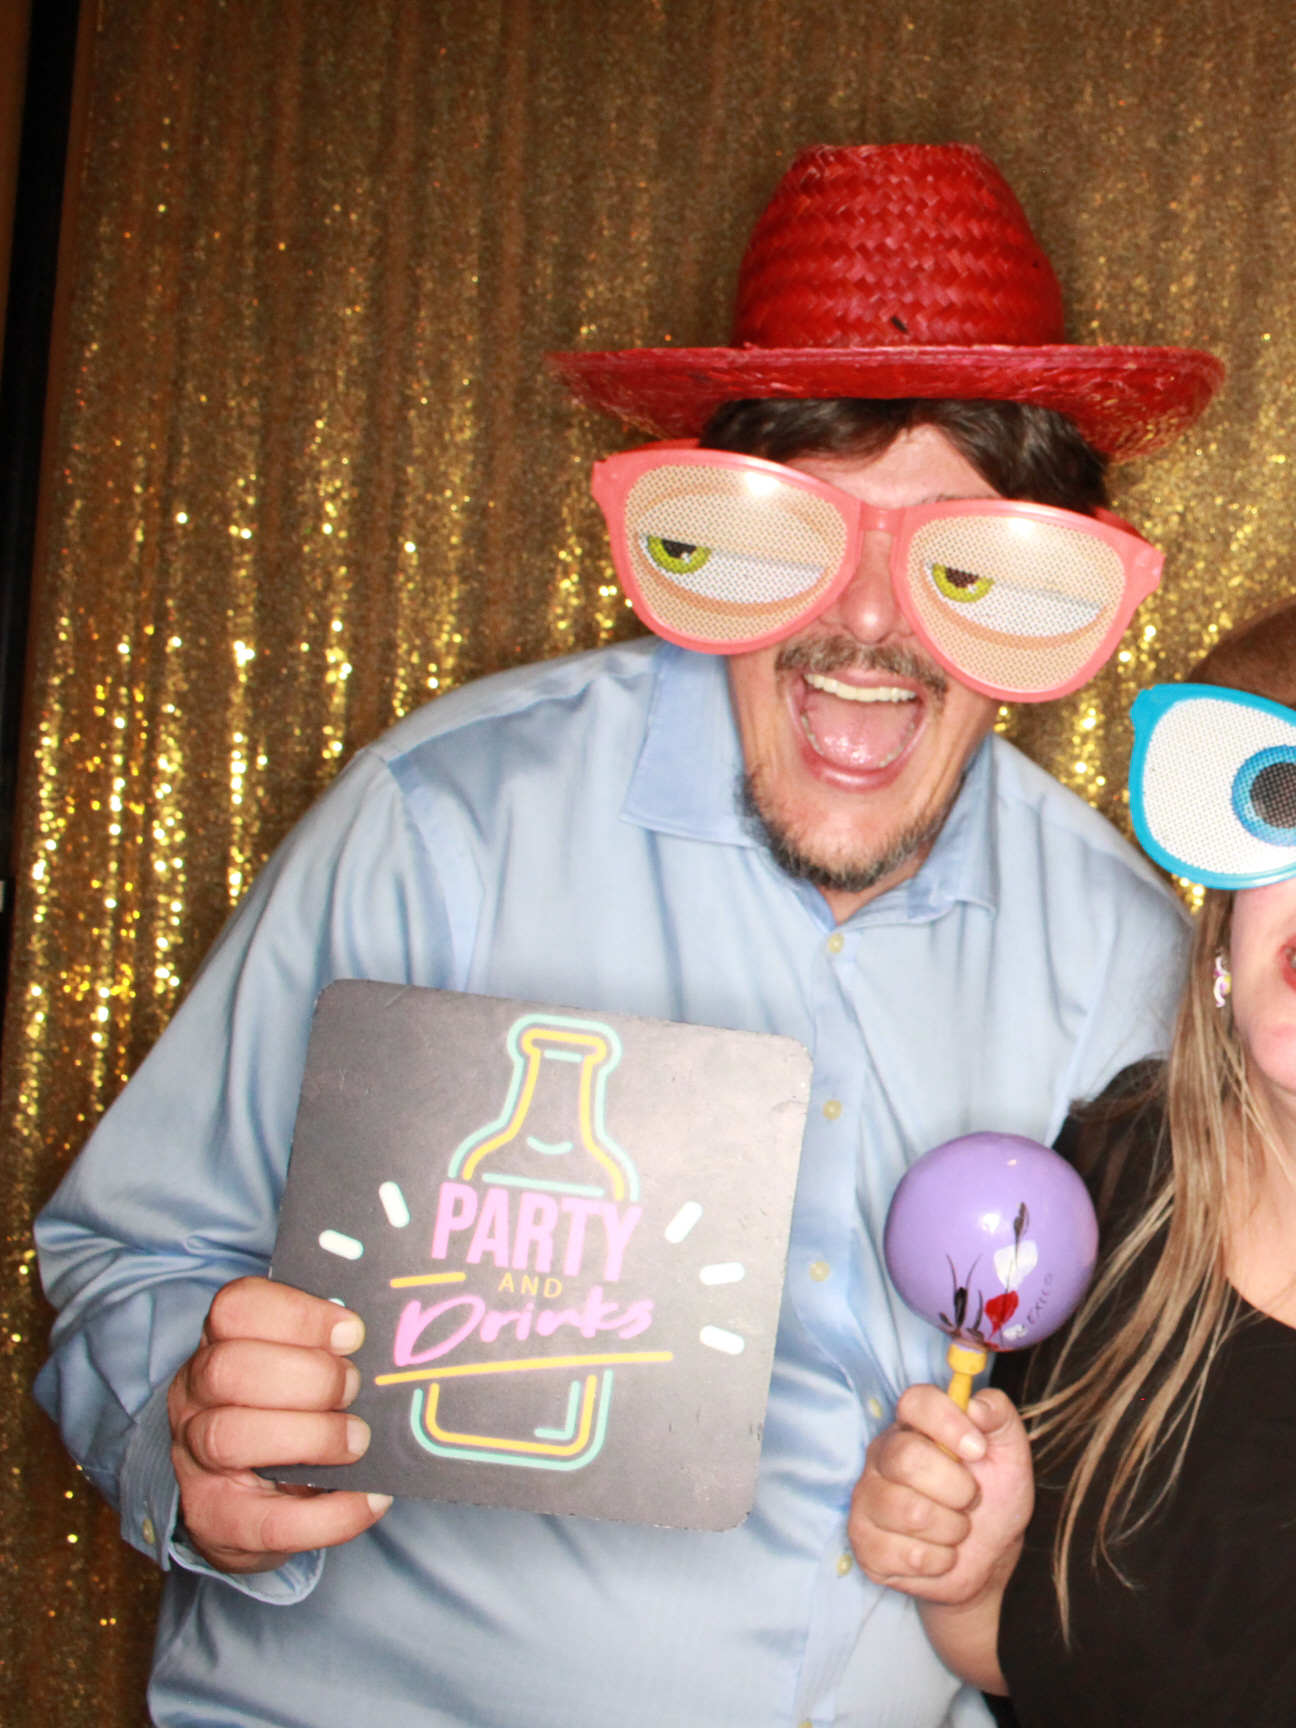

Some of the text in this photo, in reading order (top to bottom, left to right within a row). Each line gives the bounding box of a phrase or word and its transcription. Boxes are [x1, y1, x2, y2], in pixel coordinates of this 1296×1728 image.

[431, 1182, 643, 1282] PARTY
[394, 1285, 654, 1367] Drinks
[498, 1272, 563, 1298] AND
